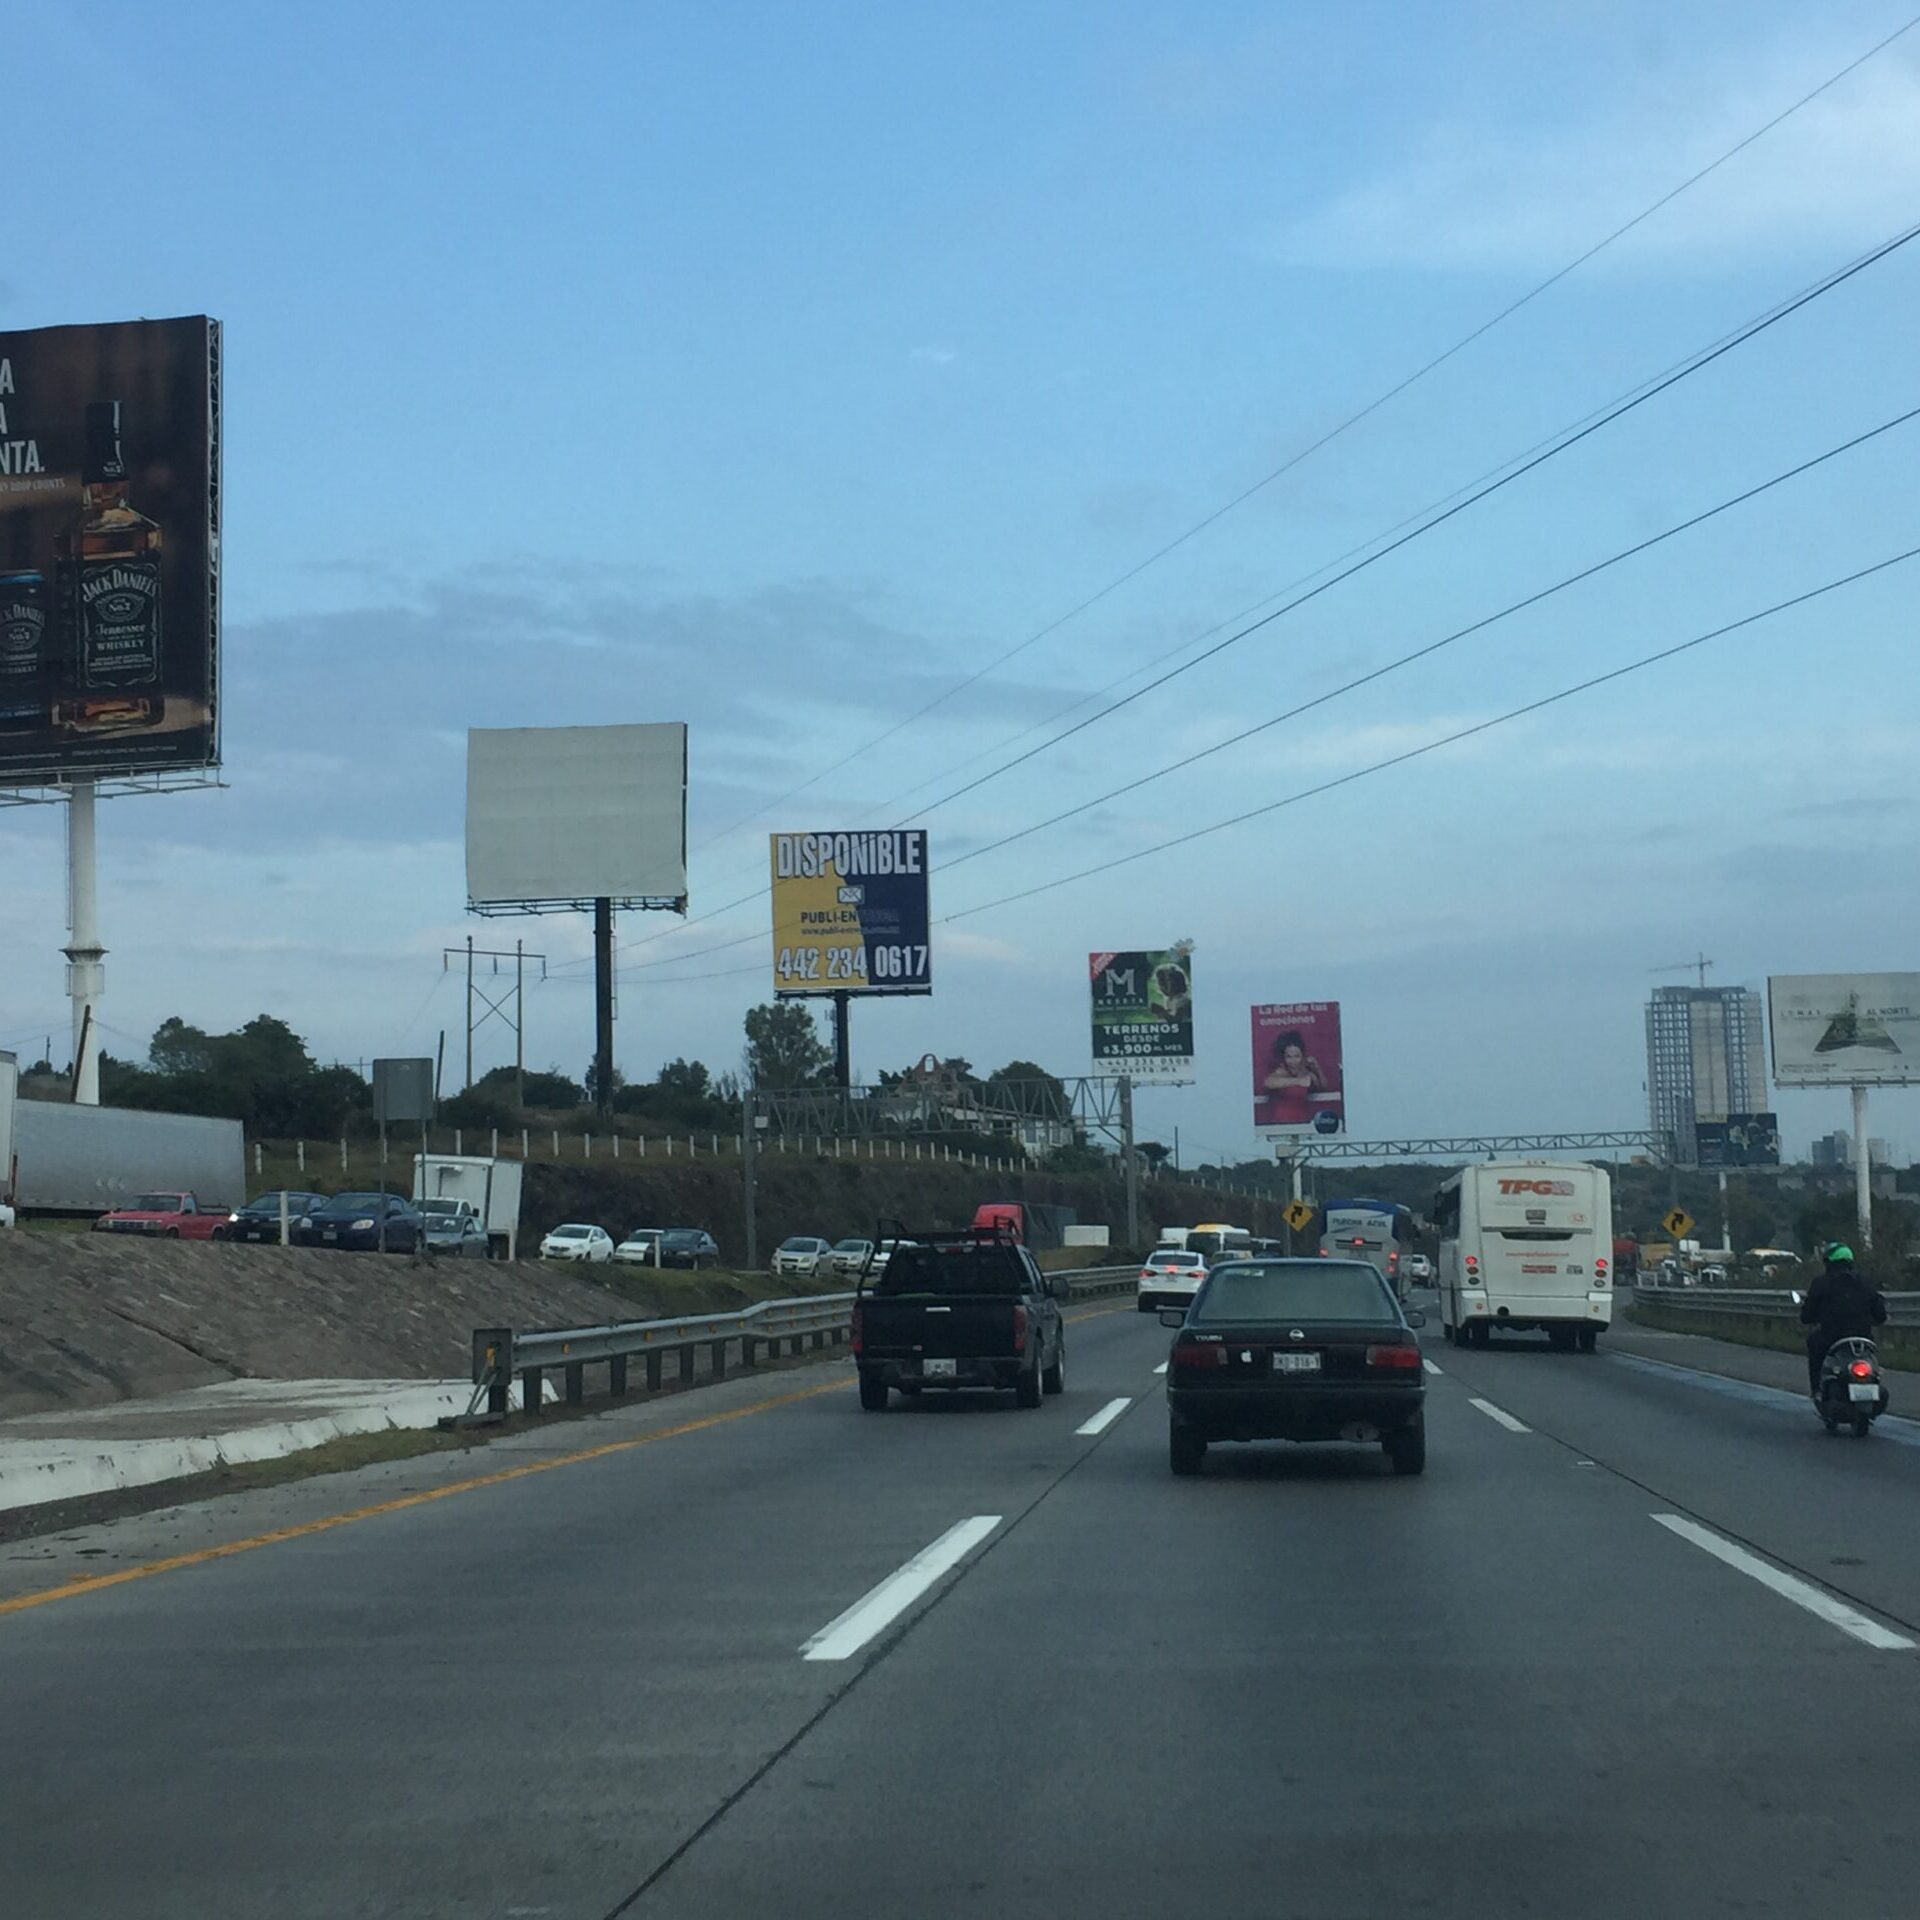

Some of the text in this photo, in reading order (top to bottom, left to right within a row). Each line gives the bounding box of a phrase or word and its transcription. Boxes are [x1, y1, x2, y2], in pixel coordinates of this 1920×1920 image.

[97, 640, 145, 651] WHISKEY
[778, 945, 928, 979] 442 234 0617
[1105, 968, 1136, 996] M
[1295, 1004, 1309, 1012] de
[1310, 1003, 1328, 1011] tus
[1260, 1015, 1316, 1026] emociones
[1104, 1023, 1179, 1035] TERRENOS
[1123, 1034, 1159, 1043] DESDE
[1498, 1179, 1552, 1195] TPG
